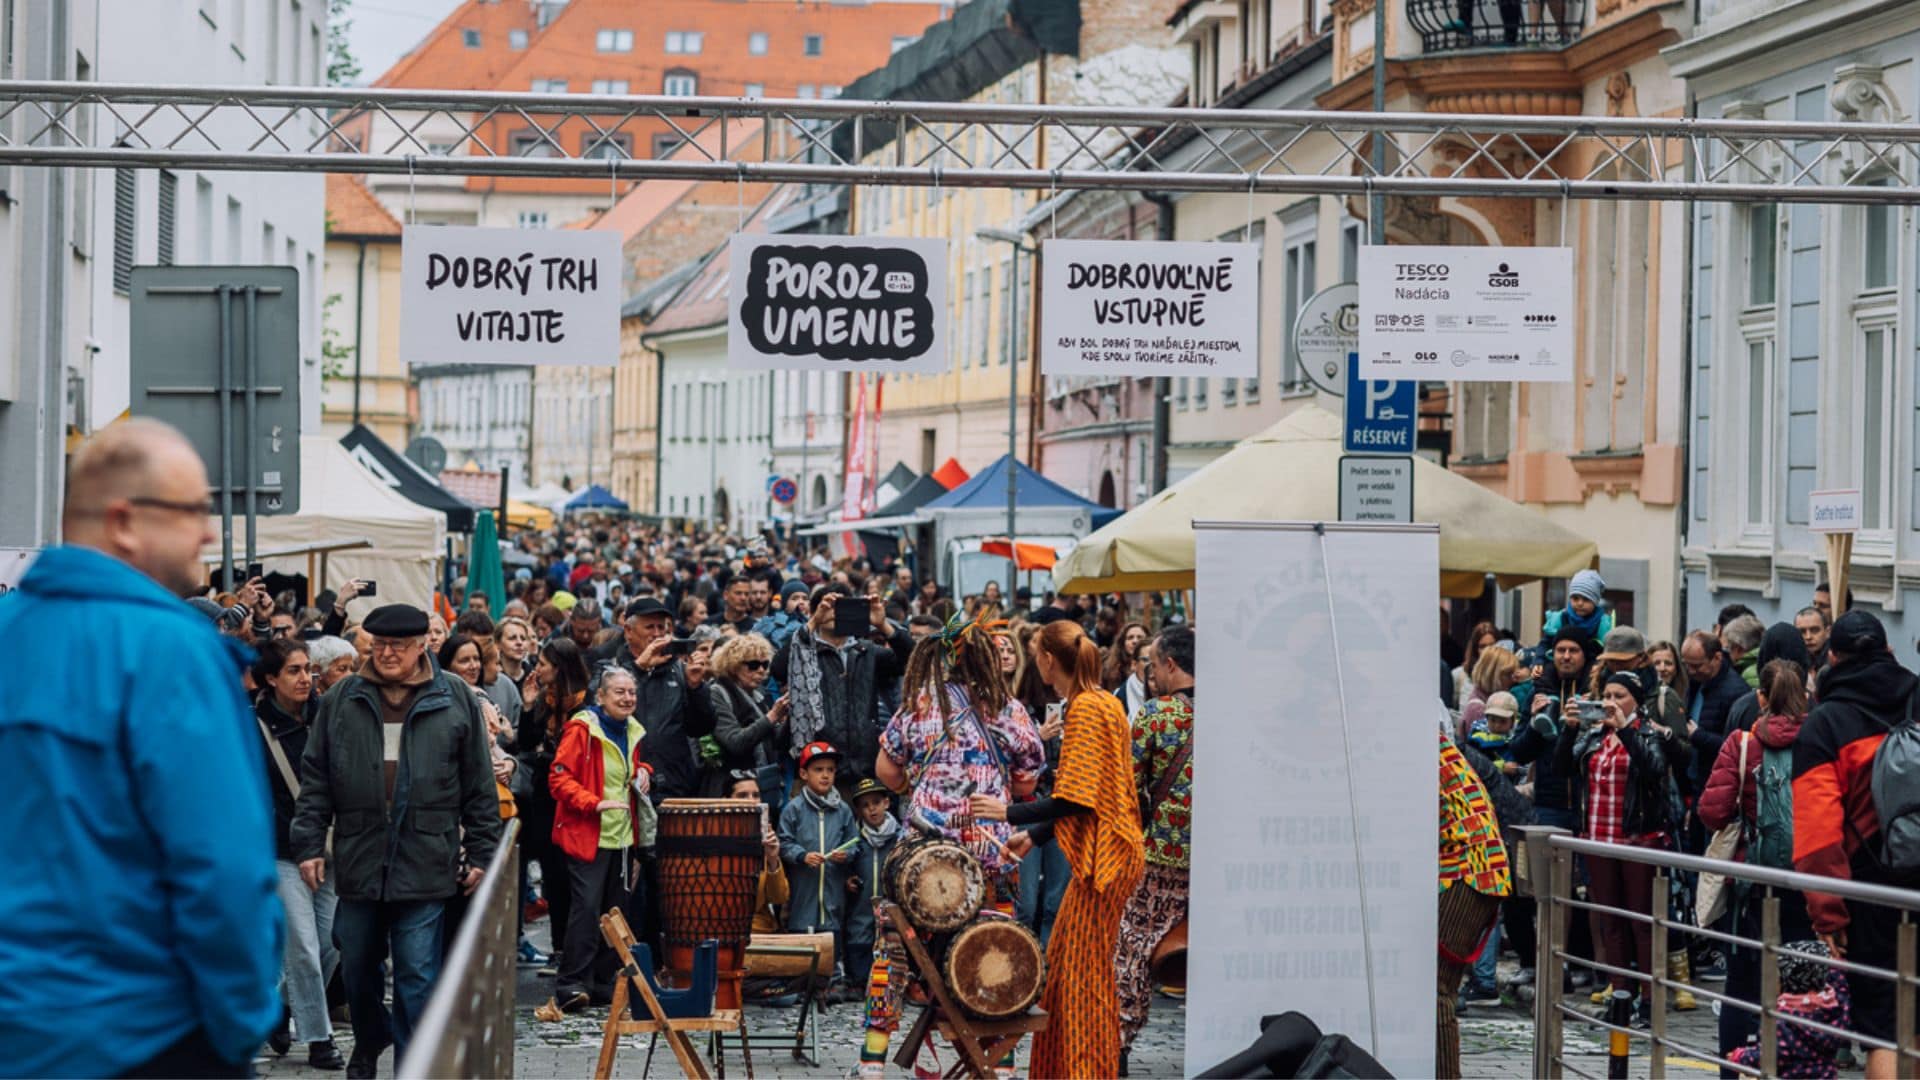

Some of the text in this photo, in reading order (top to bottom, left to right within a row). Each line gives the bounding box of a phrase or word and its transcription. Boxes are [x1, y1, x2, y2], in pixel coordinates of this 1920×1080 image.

[426, 253, 598, 295] DOBRÝ TRH
[766, 257, 881, 299] POROZ
[1068, 257, 1233, 292] DOBROVOĽNÉ
[1395, 263, 1450, 276] TESCO
[1395, 287, 1450, 300] Nadácia
[1094, 293, 1206, 327] VSTUPNÉ
[457, 309, 565, 344] VITAJTE
[763, 305, 915, 348] UMENIE
[1058, 337, 1076, 348] ABY
[1080, 338, 1098, 349] BOL
[1102, 338, 1131, 350] DOBRÝ
[1134, 339, 1149, 350] TRH
[1197, 340, 1242, 353] MIESTOM,
[1081, 351, 1100, 362] KDE
[1103, 352, 1131, 362] SPOLU
[1415, 352, 1438, 361] OLO
[1353, 426, 1408, 446] RÉSERVÉ
